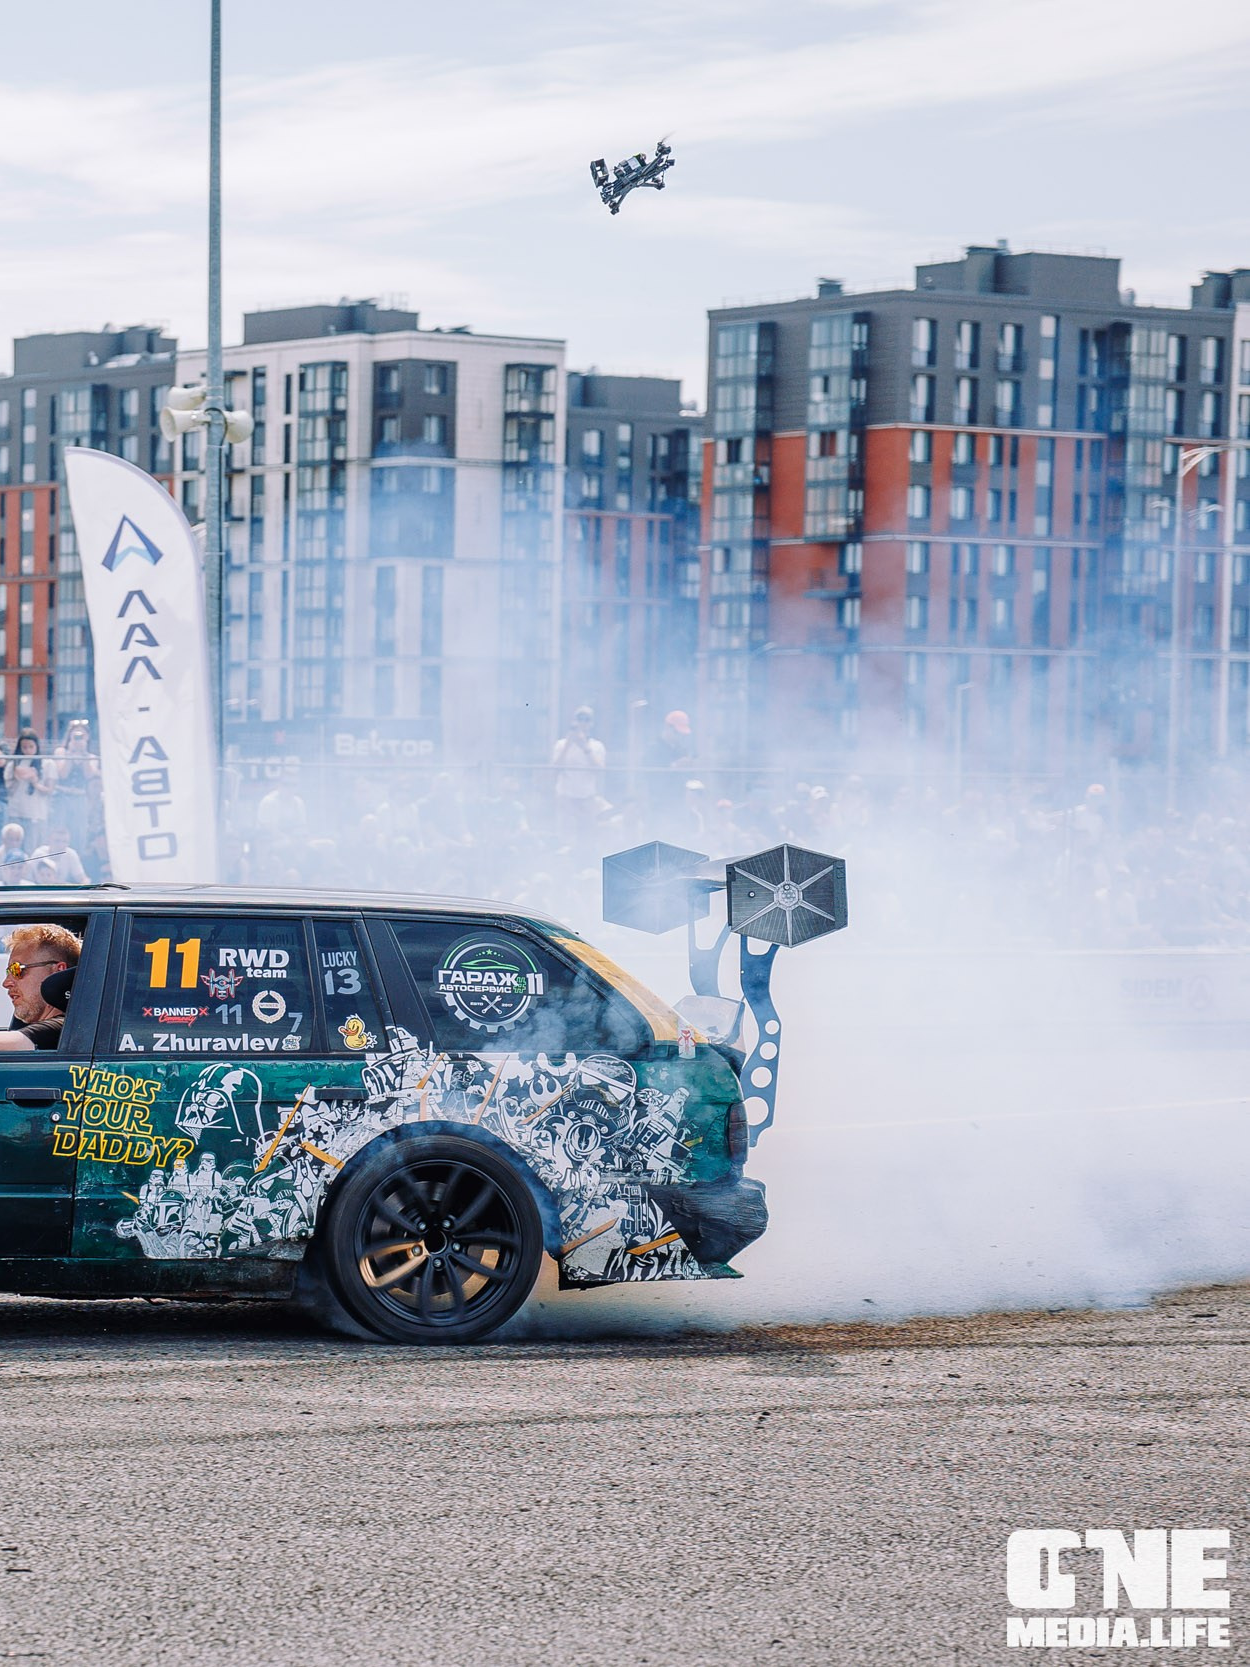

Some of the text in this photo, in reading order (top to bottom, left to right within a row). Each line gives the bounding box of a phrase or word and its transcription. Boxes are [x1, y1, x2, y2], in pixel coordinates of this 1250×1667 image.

[144, 937, 201, 989] 11
[218, 948, 290, 968] RWD
[321, 950, 358, 968] LUCKY
[246, 967, 287, 979] team
[324, 968, 362, 995] 13
[438, 970, 519, 986] ГАРАЖ
[439, 984, 512, 994] АВТОСЕРВИС
[153, 1007, 199, 1017] BANNED
[215, 1003, 243, 1024] 11
[118, 1033, 279, 1052] A. Zhuravlev
[69, 1065, 162, 1104] WHO'S
[62, 1091, 153, 1135] YOUR
[52, 1125, 195, 1168] DADDY?
